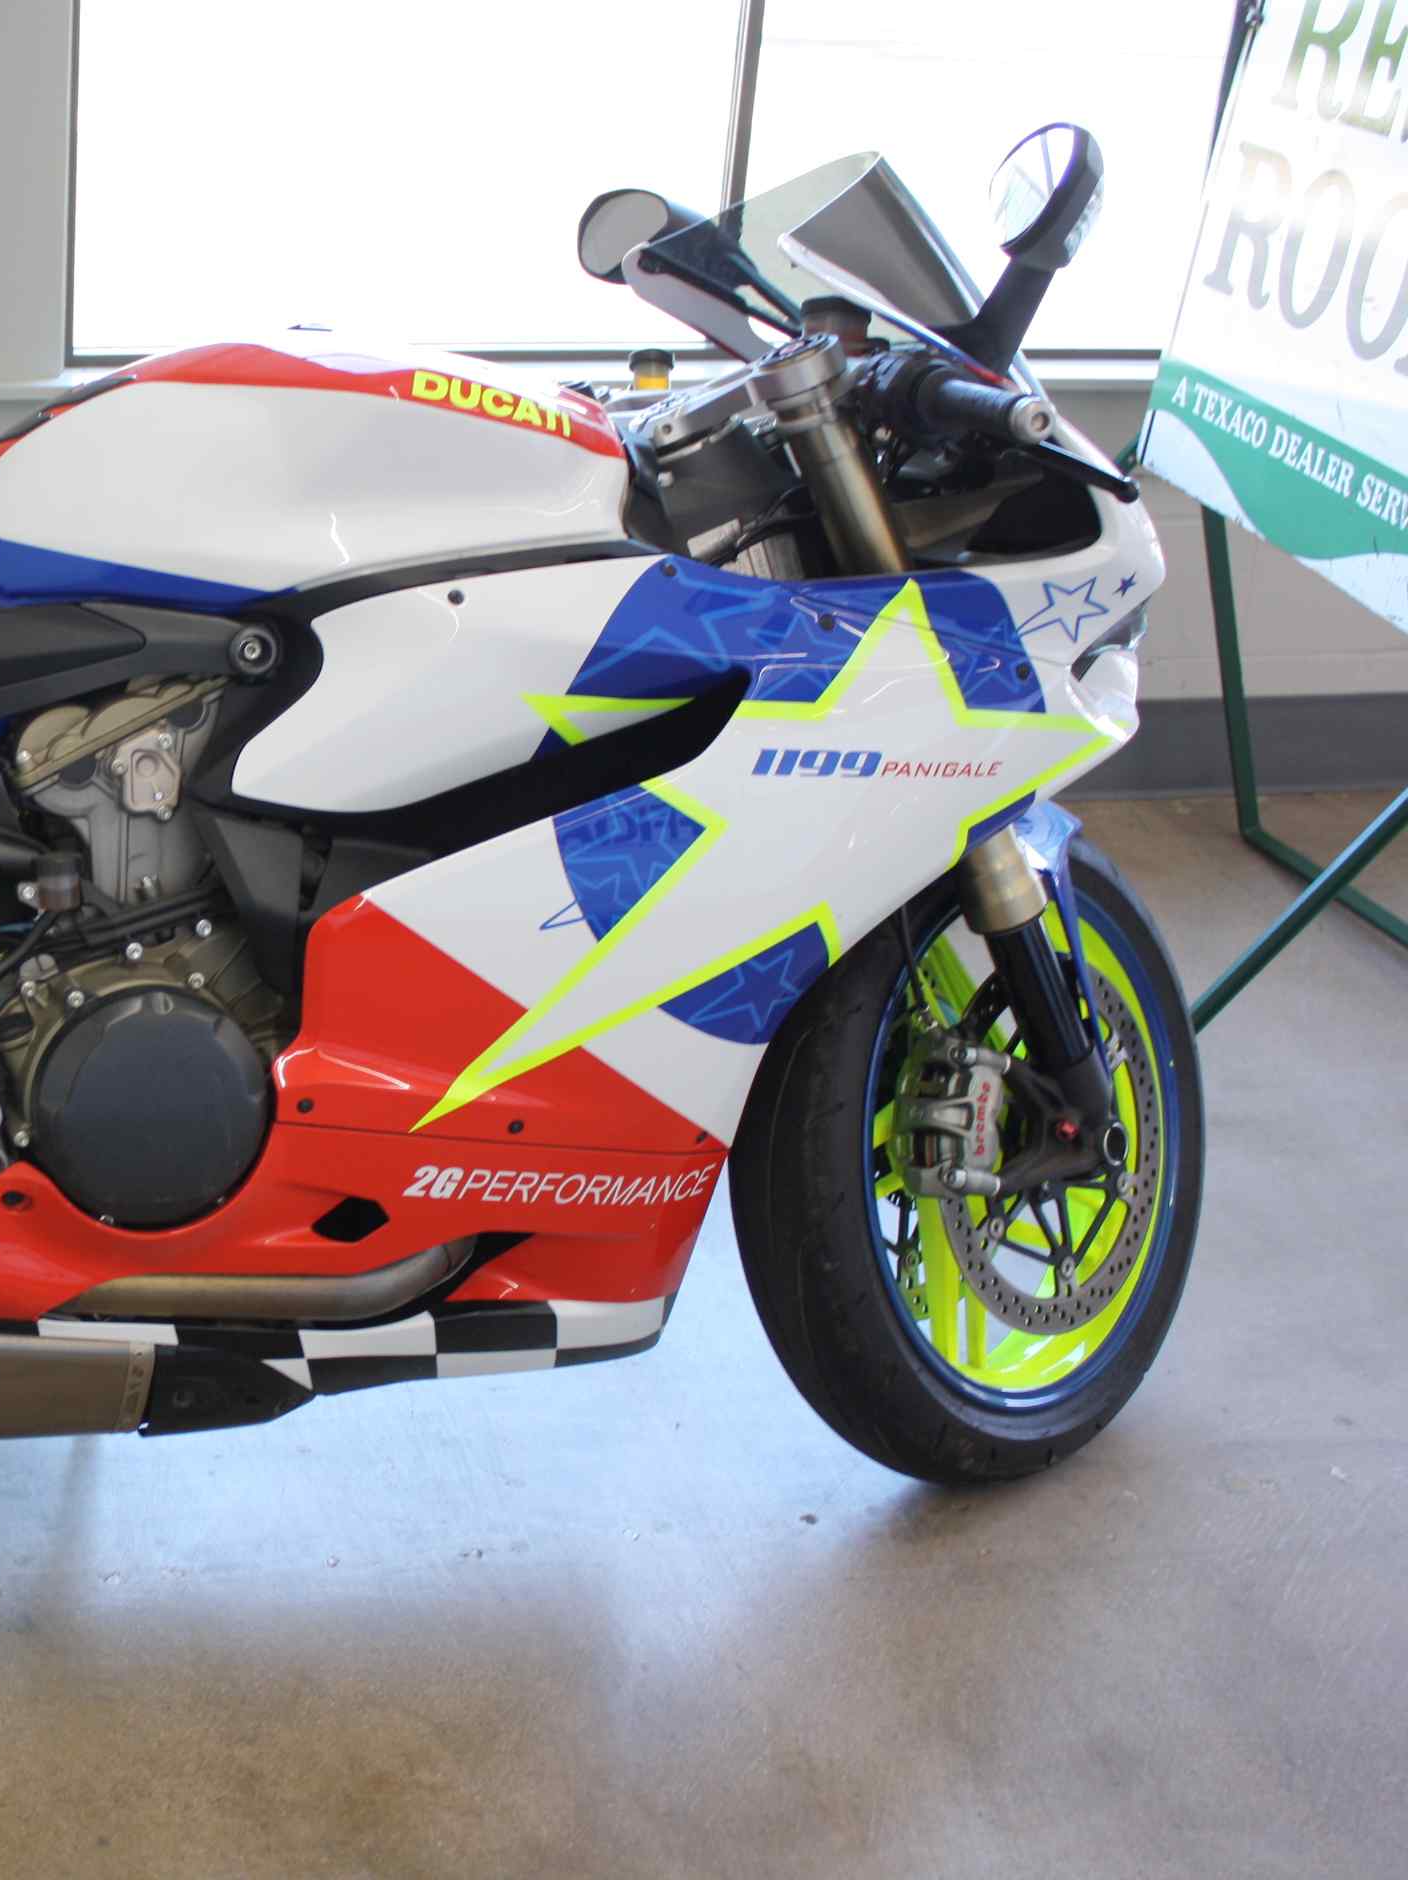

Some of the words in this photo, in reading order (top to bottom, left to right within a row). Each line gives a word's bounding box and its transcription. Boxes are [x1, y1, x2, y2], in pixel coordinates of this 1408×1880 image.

[1270, 0, 1408, 142] RE
[1202, 140, 1408, 378] ROO
[411, 369, 572, 437] DUCATI
[1171, 376, 1189, 409] A
[1192, 387, 1268, 448] TEXACO
[1268, 426, 1356, 498] DEALER
[752, 749, 883, 777] 1199
[881, 761, 1003, 777] PANIGALE
[403, 1165, 460, 1198] 2G
[458, 1163, 716, 1206] PERFORMANCE
